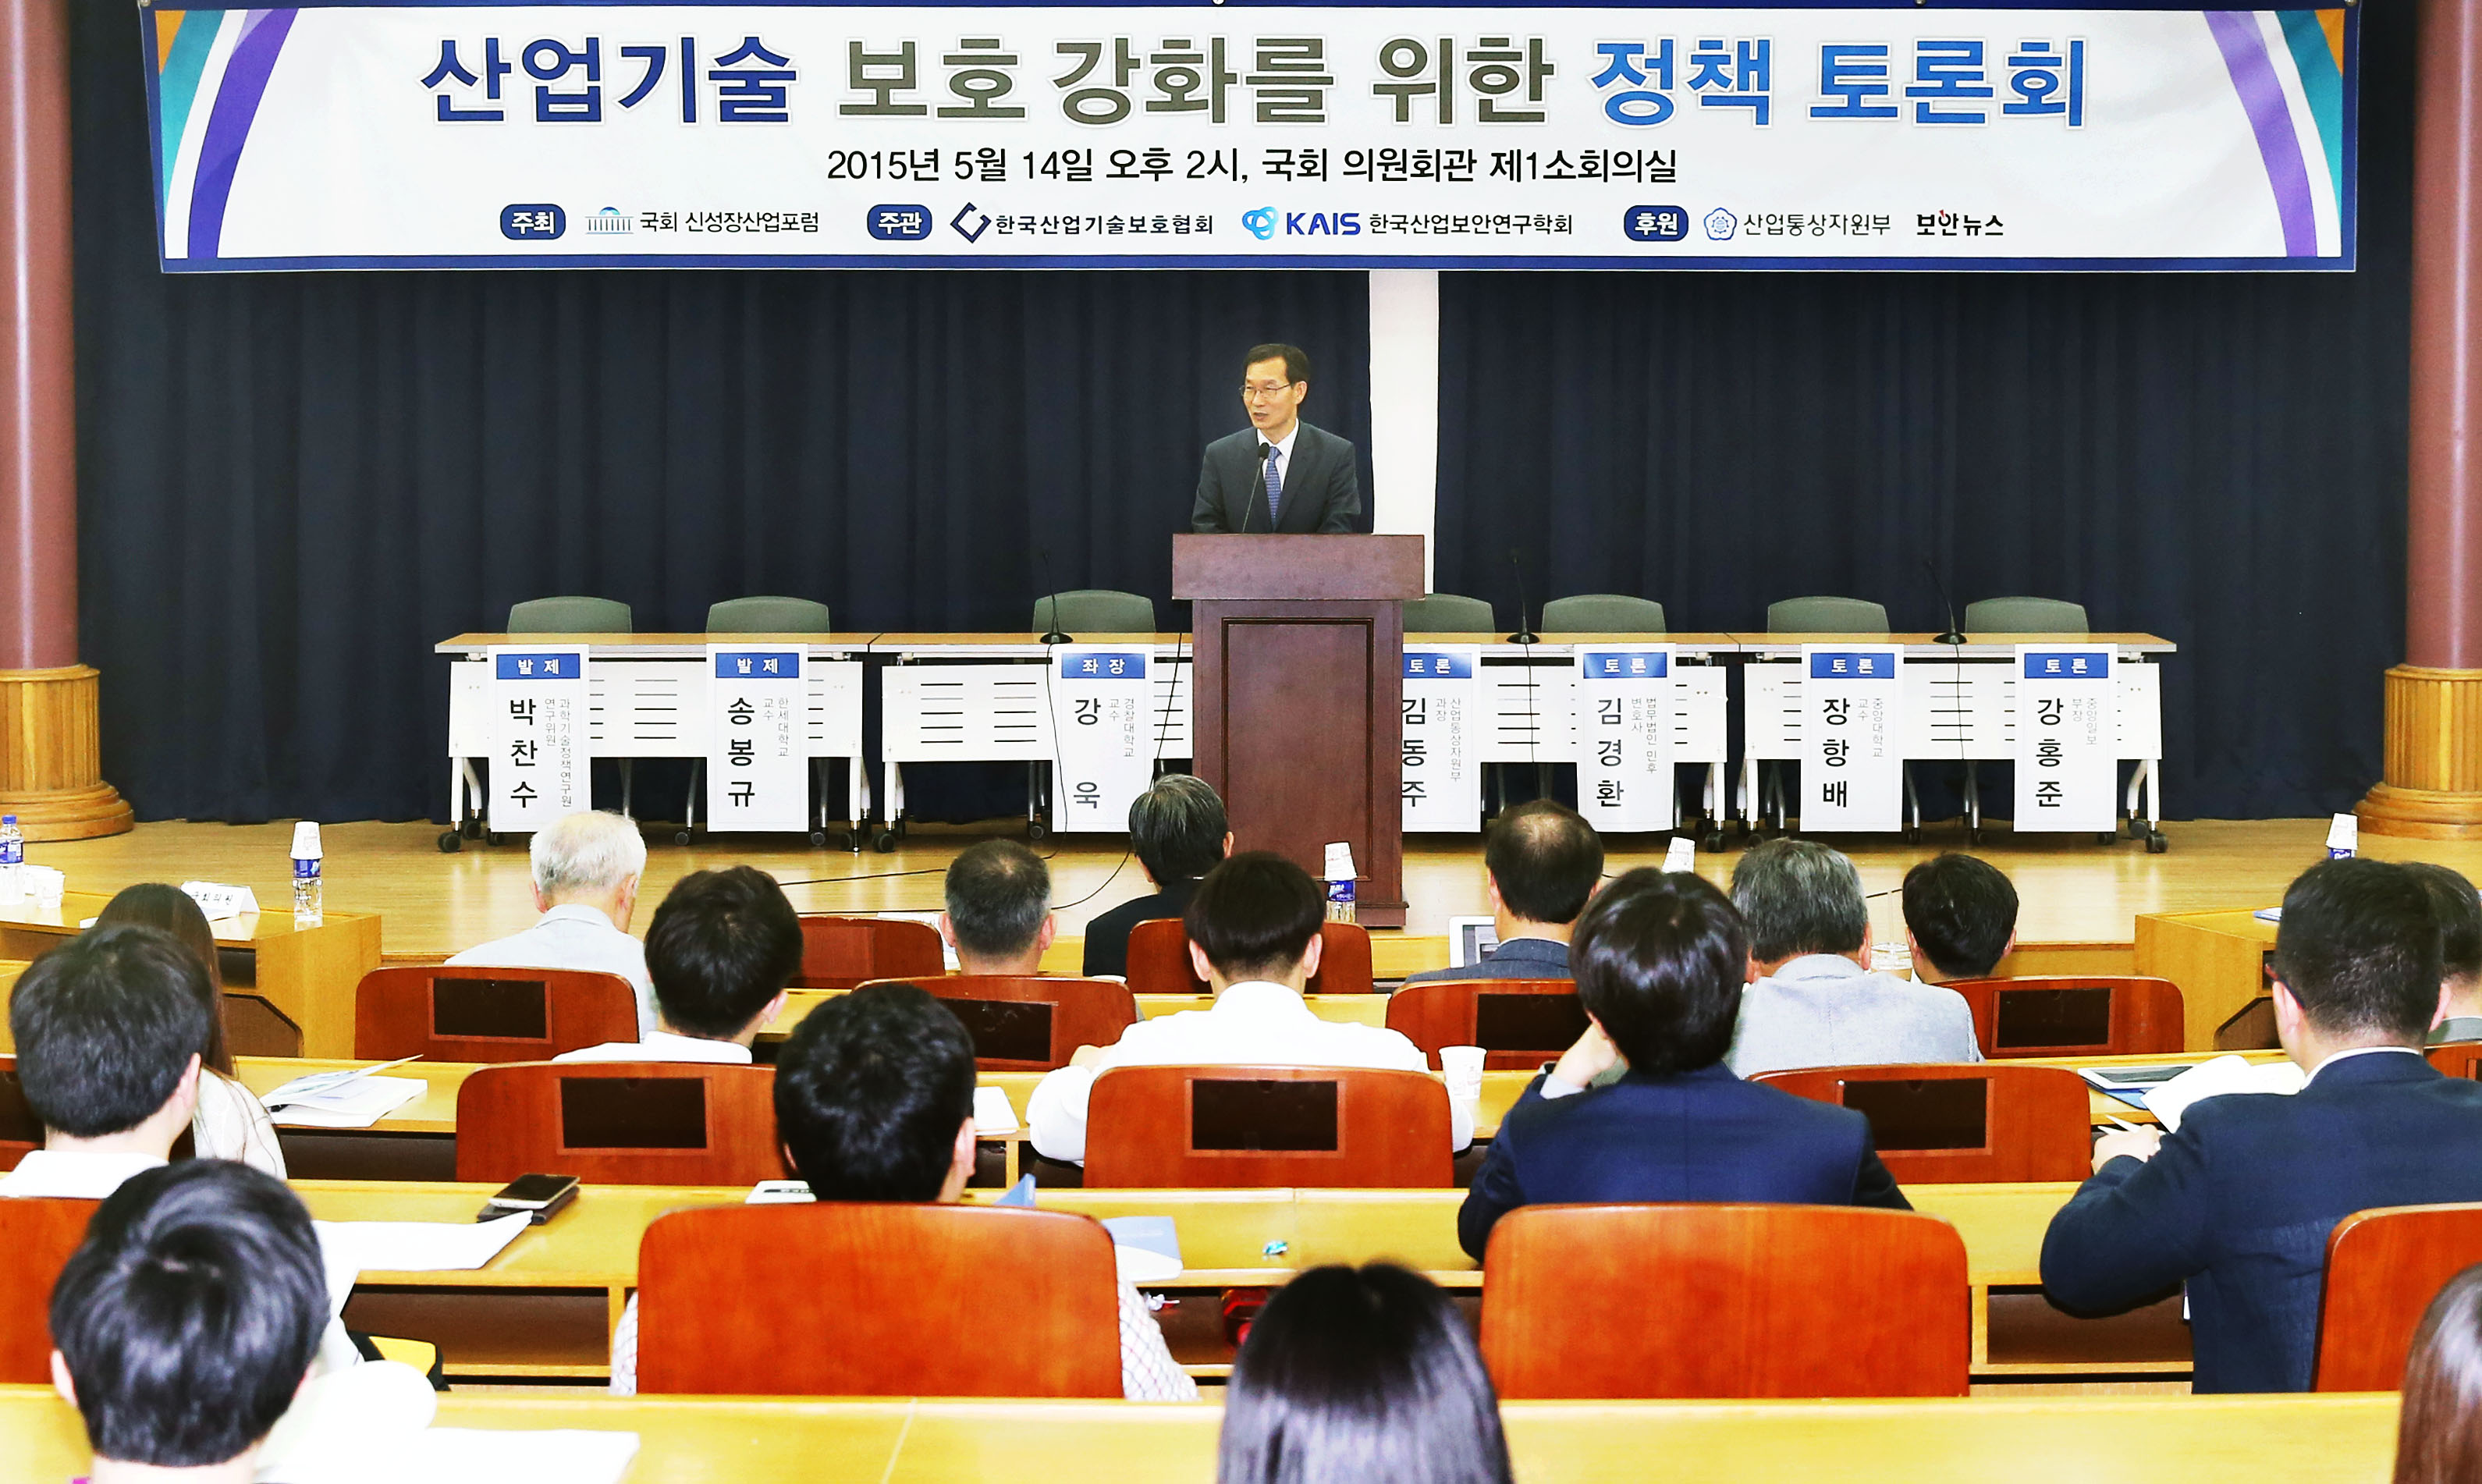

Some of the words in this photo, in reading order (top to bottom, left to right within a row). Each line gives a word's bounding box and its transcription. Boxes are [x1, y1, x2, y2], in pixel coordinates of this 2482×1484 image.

[420, 37, 797, 123] 산업기술
[839, 38, 1025, 119] 보호
[1053, 37, 1334, 125] 강화를
[1372, 37, 1554, 125] 위한
[1591, 38, 1773, 127] 정책
[1809, 39, 2085, 128] 토론회
[827, 148, 939, 182] 2015년
[954, 147, 1007, 182] 5월
[1023, 148, 1092, 182] 14일
[1106, 147, 1174, 182] 오후
[1186, 147, 1248, 183] 2시,
[1262, 147, 1327, 183] 국회
[1343, 147, 1478, 183] 의원회관
[1489, 148, 1676, 183] 제1소회의실
[511, 211, 556, 234] 주최
[640, 211, 677, 233] 국회
[685, 211, 818, 233] 신성장산업포럼
[878, 211, 922, 235] 주관
[995, 215, 1213, 235] 한국산업기술보호협회
[1286, 212, 1361, 236] KAIS
[1369, 213, 1572, 235] 한국산업보안연구학회
[1635, 212, 1679, 236] 후원
[1744, 214, 1891, 236] 산업통상자원부
[1916, 210, 2004, 236] 보안뉴스
[762, 698, 774, 721] 교수
[1109, 698, 1120, 722] 교수
[1436, 698, 1447, 722] 과장
[1631, 697, 1642, 733] 변호사
[1646, 697, 1657, 746] 법무법인
[1858, 698, 1869, 722] 교수
[2072, 698, 2083, 722] 부장
[544, 698, 556, 747] 연구위원
[777, 697, 790, 757] 한세대학교
[1123, 697, 1135, 758] 경찰대학교
[1872, 698, 1884, 758] 중앙대학교
[2086, 698, 2097, 746] 중앙일보
[1450, 697, 1461, 783] 산업통상자원부
[559, 698, 572, 808] 과학기술정책연구원
